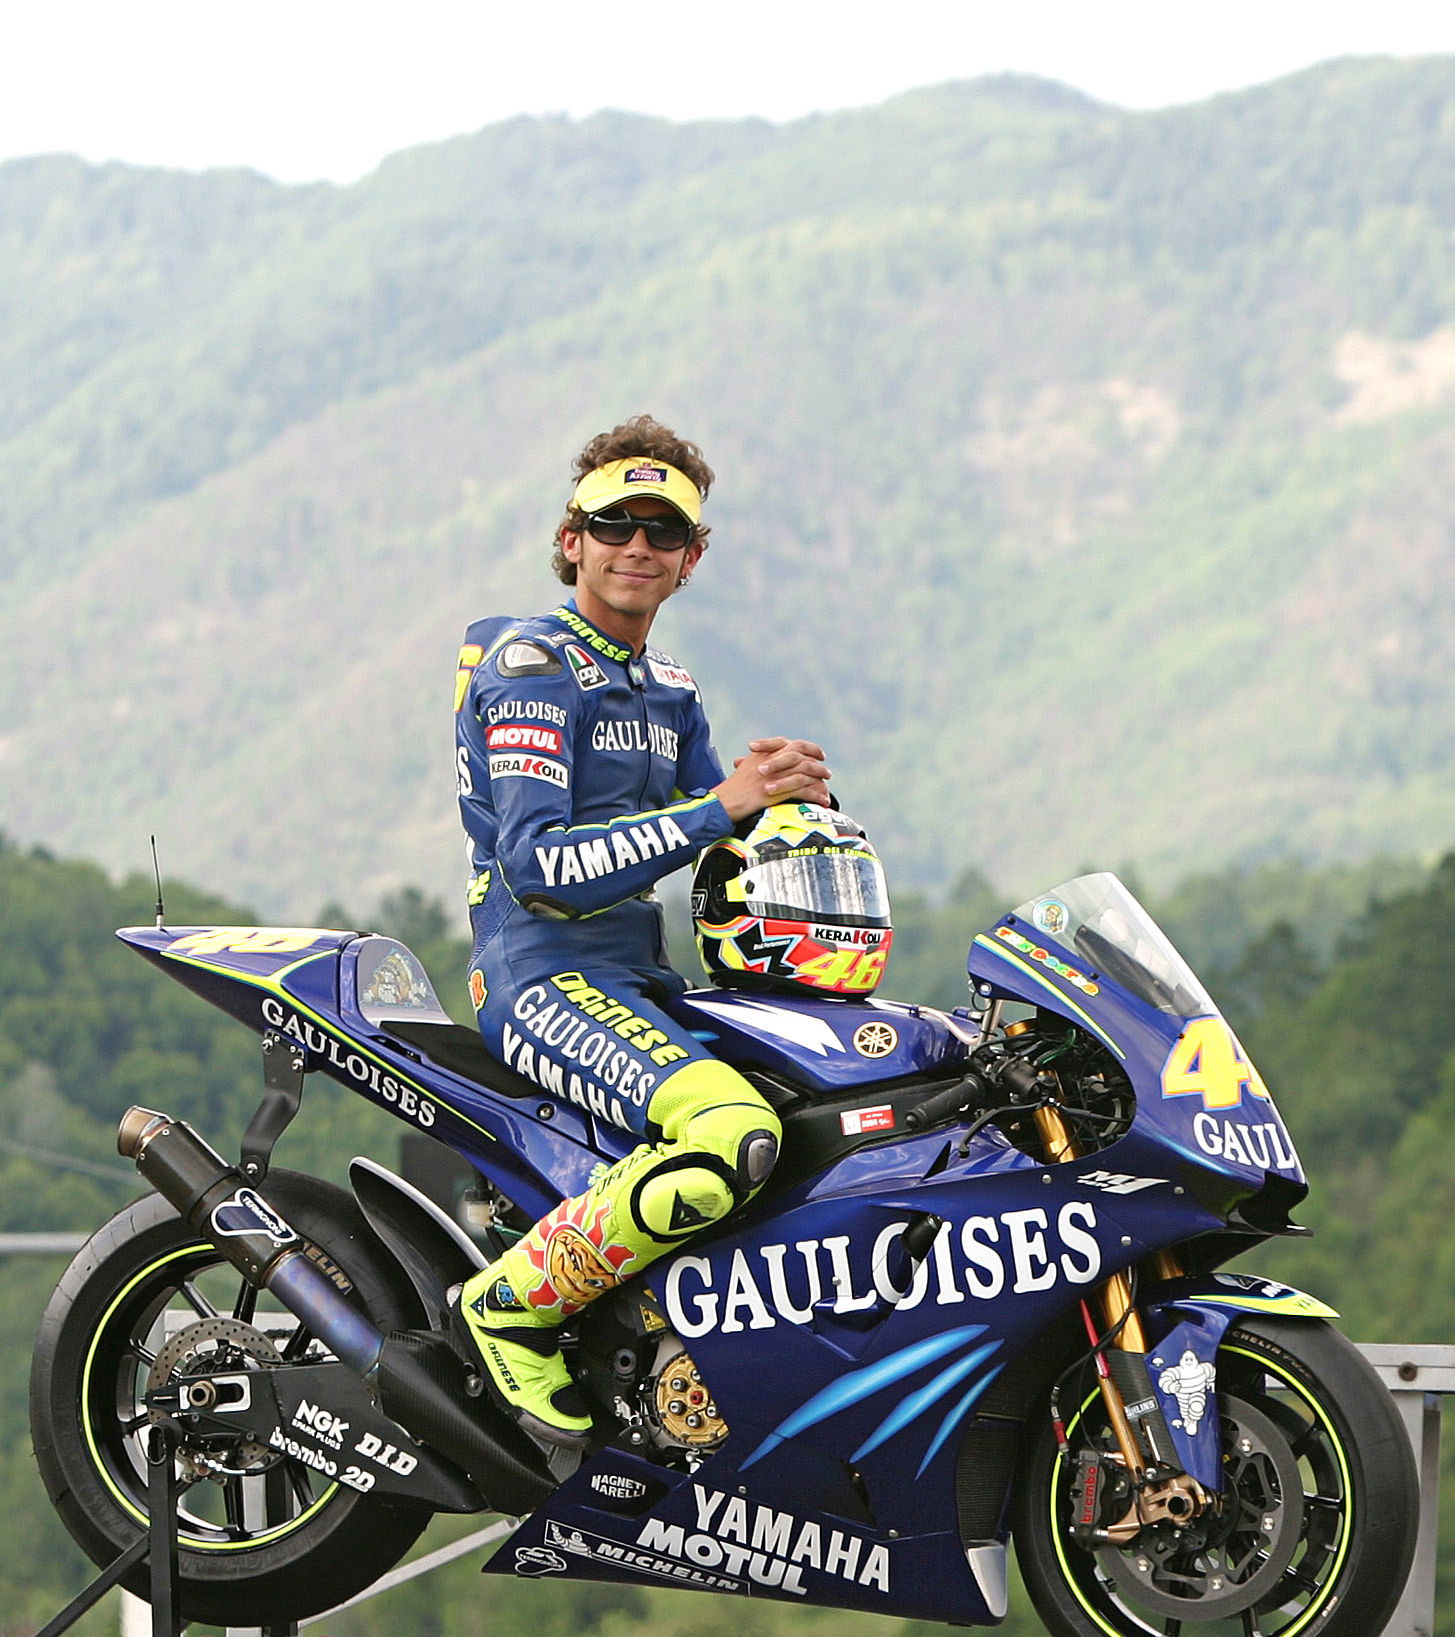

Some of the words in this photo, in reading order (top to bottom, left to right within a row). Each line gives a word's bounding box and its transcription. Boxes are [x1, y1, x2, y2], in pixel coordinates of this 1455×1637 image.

[549, 607, 630, 662] DAINESE
[487, 700, 567, 727] GAULOISES
[489, 727, 559, 750] MOTUL
[591, 720, 679, 762] GAULOISES
[491, 758, 567, 783] KERAKOLL
[534, 815, 690, 888] YAMAHA
[796, 950, 887, 990] 46
[513, 985, 657, 1108] GAULOISES
[550, 971, 690, 1068] DAINESE
[261, 997, 438, 1128] GAULOISES
[500, 1021, 635, 1134] YAMAHA
[664, 1201, 1103, 1340] GAULOISES
[487, 1342, 521, 1393] DAINESE
[294, 1399, 350, 1443] NGK
[269, 1426, 338, 1476] brembo
[1080, 1466, 1098, 1523] brembo
[636, 1518, 808, 1596] MOTUL
[694, 1483, 892, 1594] YAMAHA
[596, 1542, 740, 1592] MICHELIN
